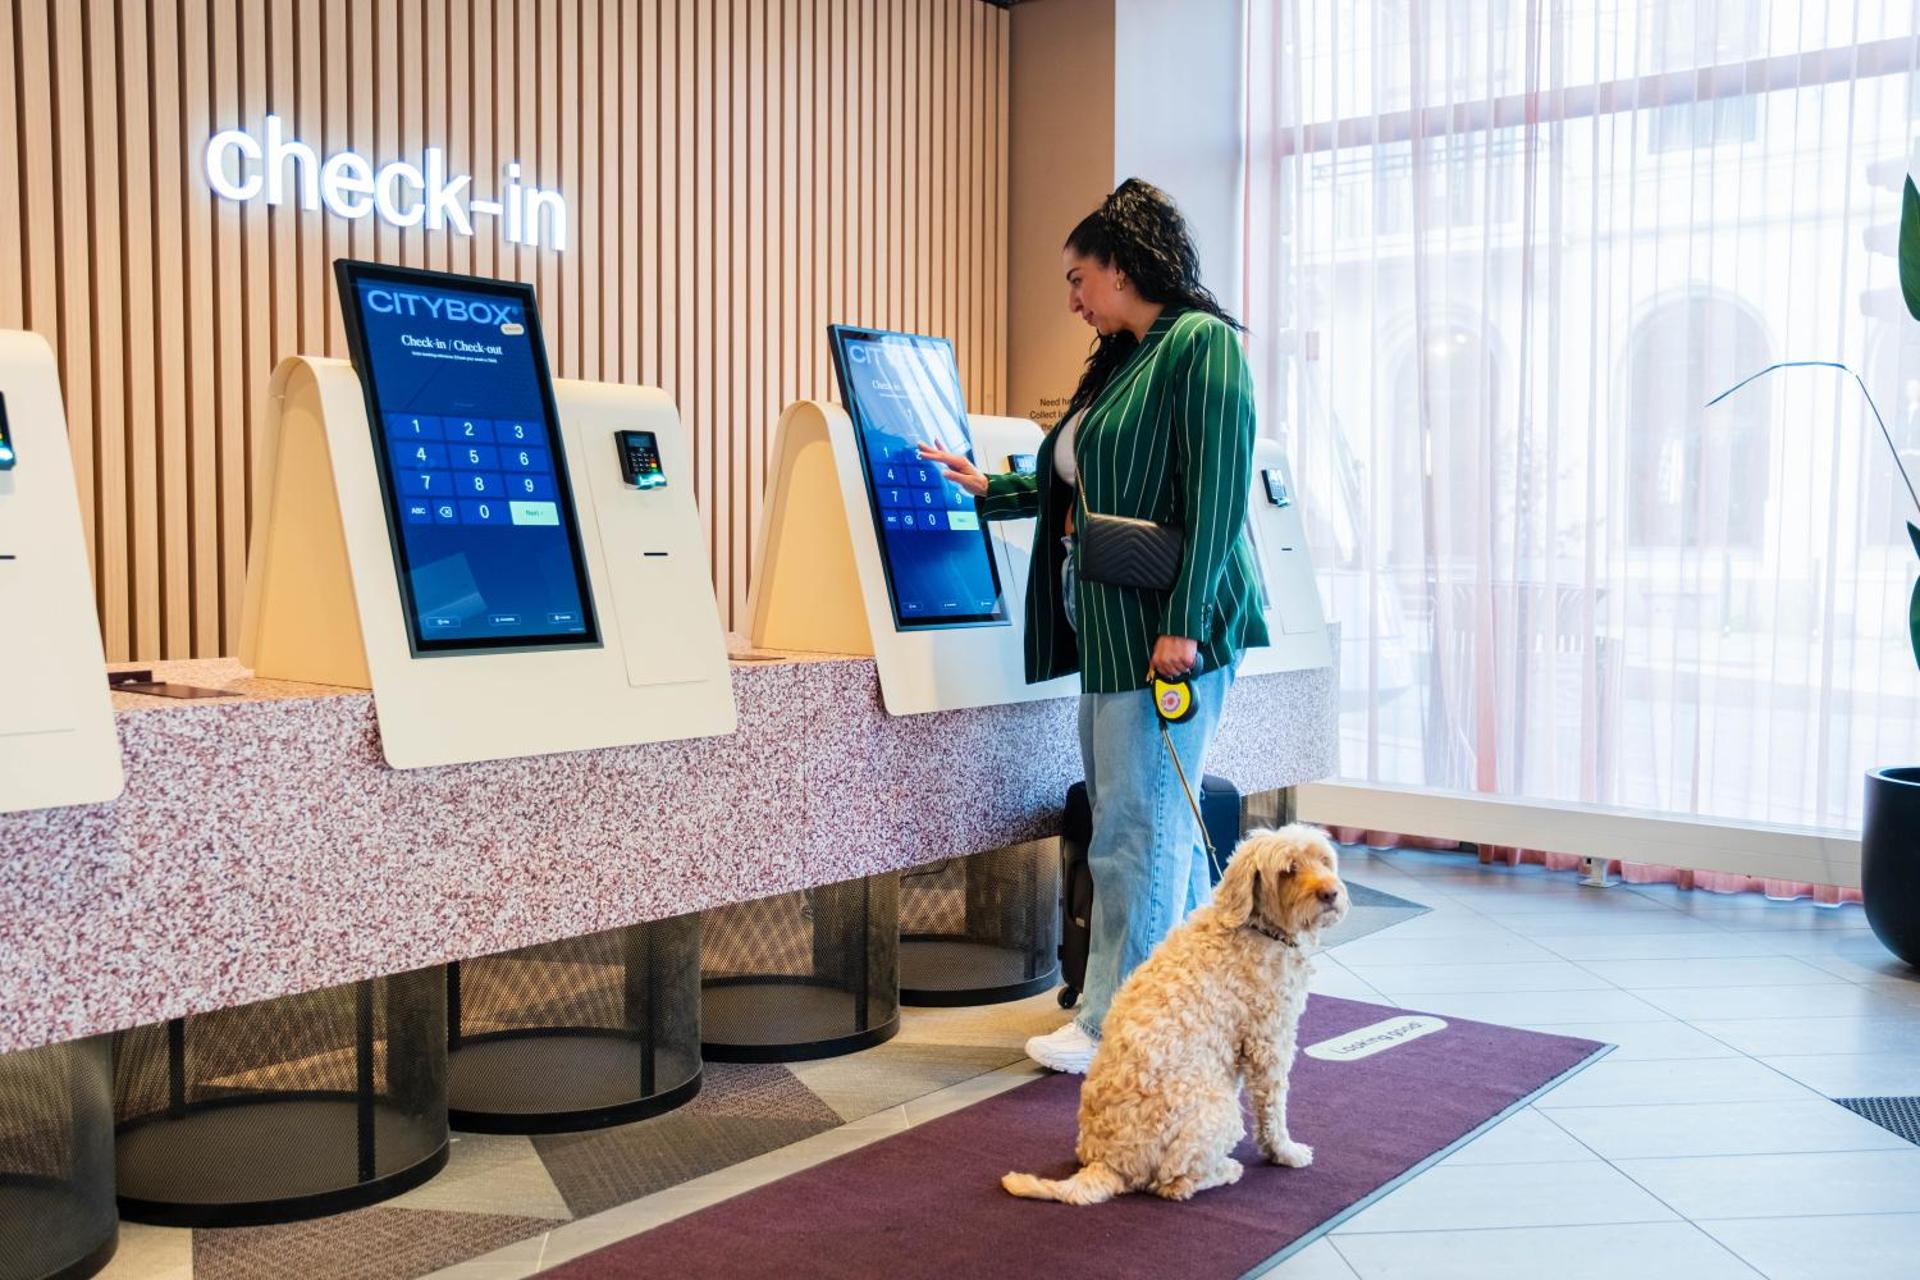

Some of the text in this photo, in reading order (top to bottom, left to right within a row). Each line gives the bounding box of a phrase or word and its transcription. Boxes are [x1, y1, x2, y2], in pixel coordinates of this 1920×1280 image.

[206, 115, 566, 250] check-in
[401, 334, 447, 350] Check-in
[453, 339, 503, 355] Check-out
[1040, 398, 1061, 407] Need
[1029, 410, 1057, 420] Collect
[412, 419, 524, 439] 1 2 3
[416, 447, 529, 466] 4 5 6
[883, 446, 889, 458] 1
[887, 468, 927, 482] 4 5
[421, 475, 534, 493] 7 8 9
[891, 491, 962, 505] 7 8 9
[479, 504, 490, 519] 0
[928, 513, 936, 526] 0
